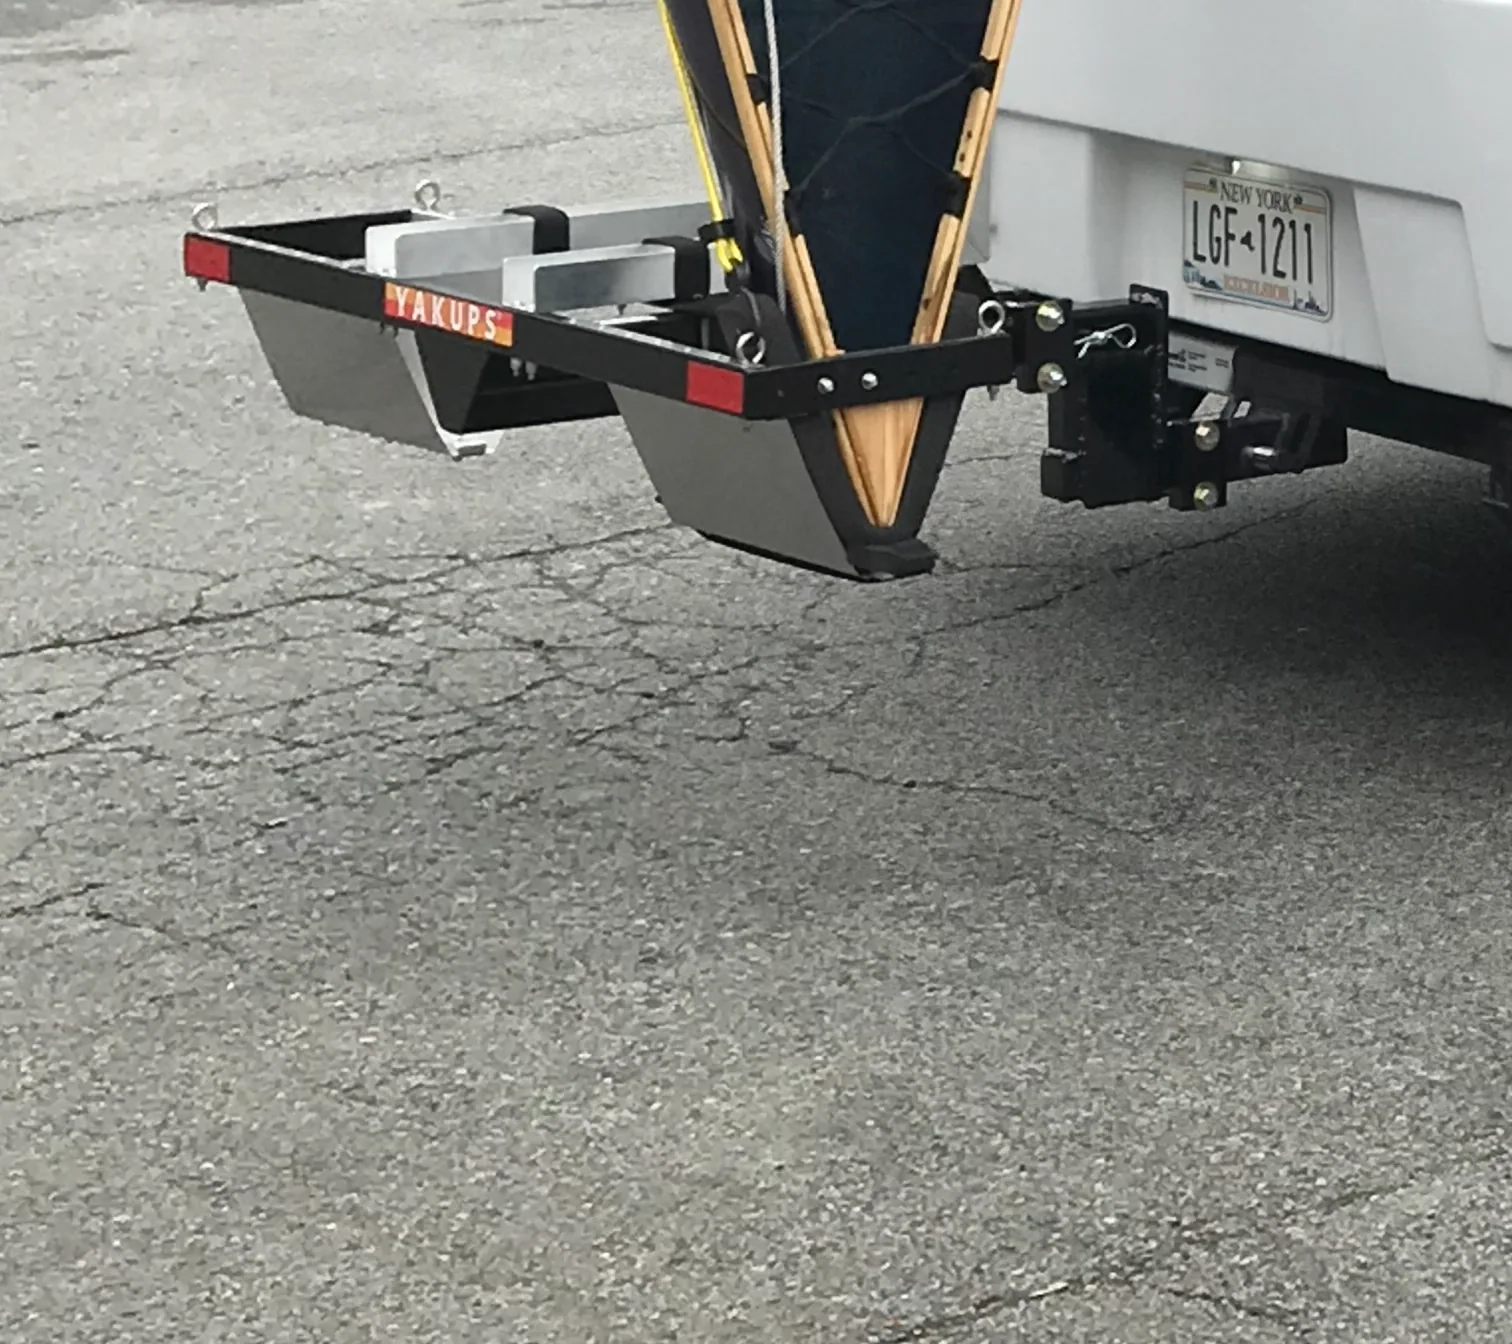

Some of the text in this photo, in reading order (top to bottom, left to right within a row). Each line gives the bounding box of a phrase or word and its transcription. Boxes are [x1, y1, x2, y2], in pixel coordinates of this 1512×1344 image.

[1219, 181, 1293, 214] NEW YORK
[394, 286, 497, 341] YAKUPS
